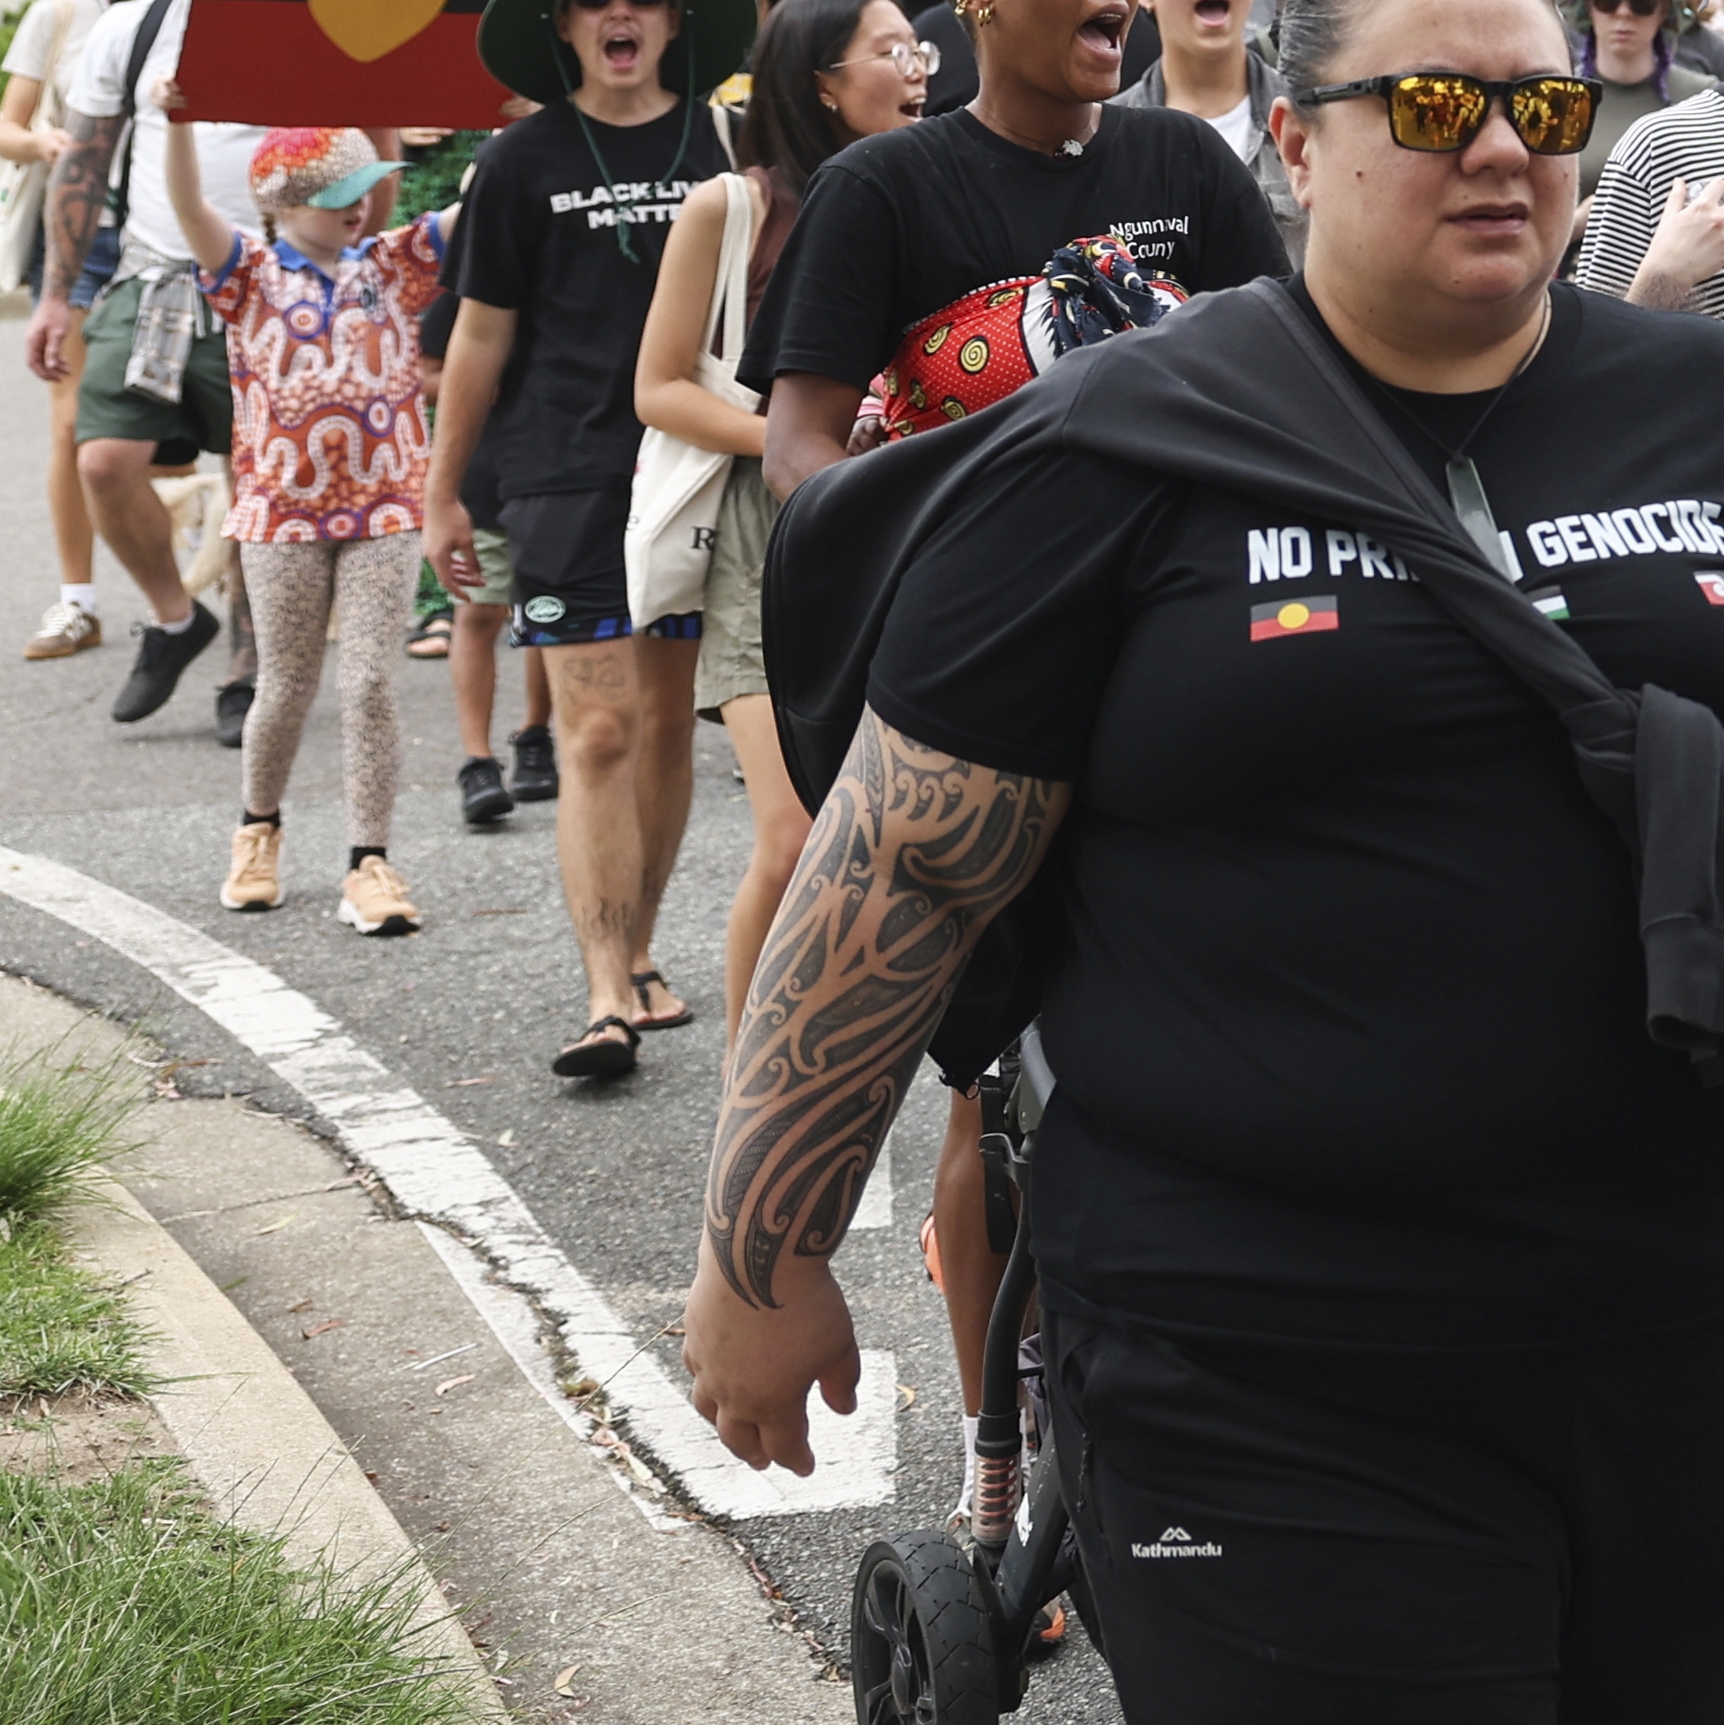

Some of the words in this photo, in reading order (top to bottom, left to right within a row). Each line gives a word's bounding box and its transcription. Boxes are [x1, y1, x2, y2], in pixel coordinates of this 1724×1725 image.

[550, 182, 652, 213] BLACK
[1248, 526, 1313, 584] NO
[1131, 1541, 1222, 1558] Kathmandu
